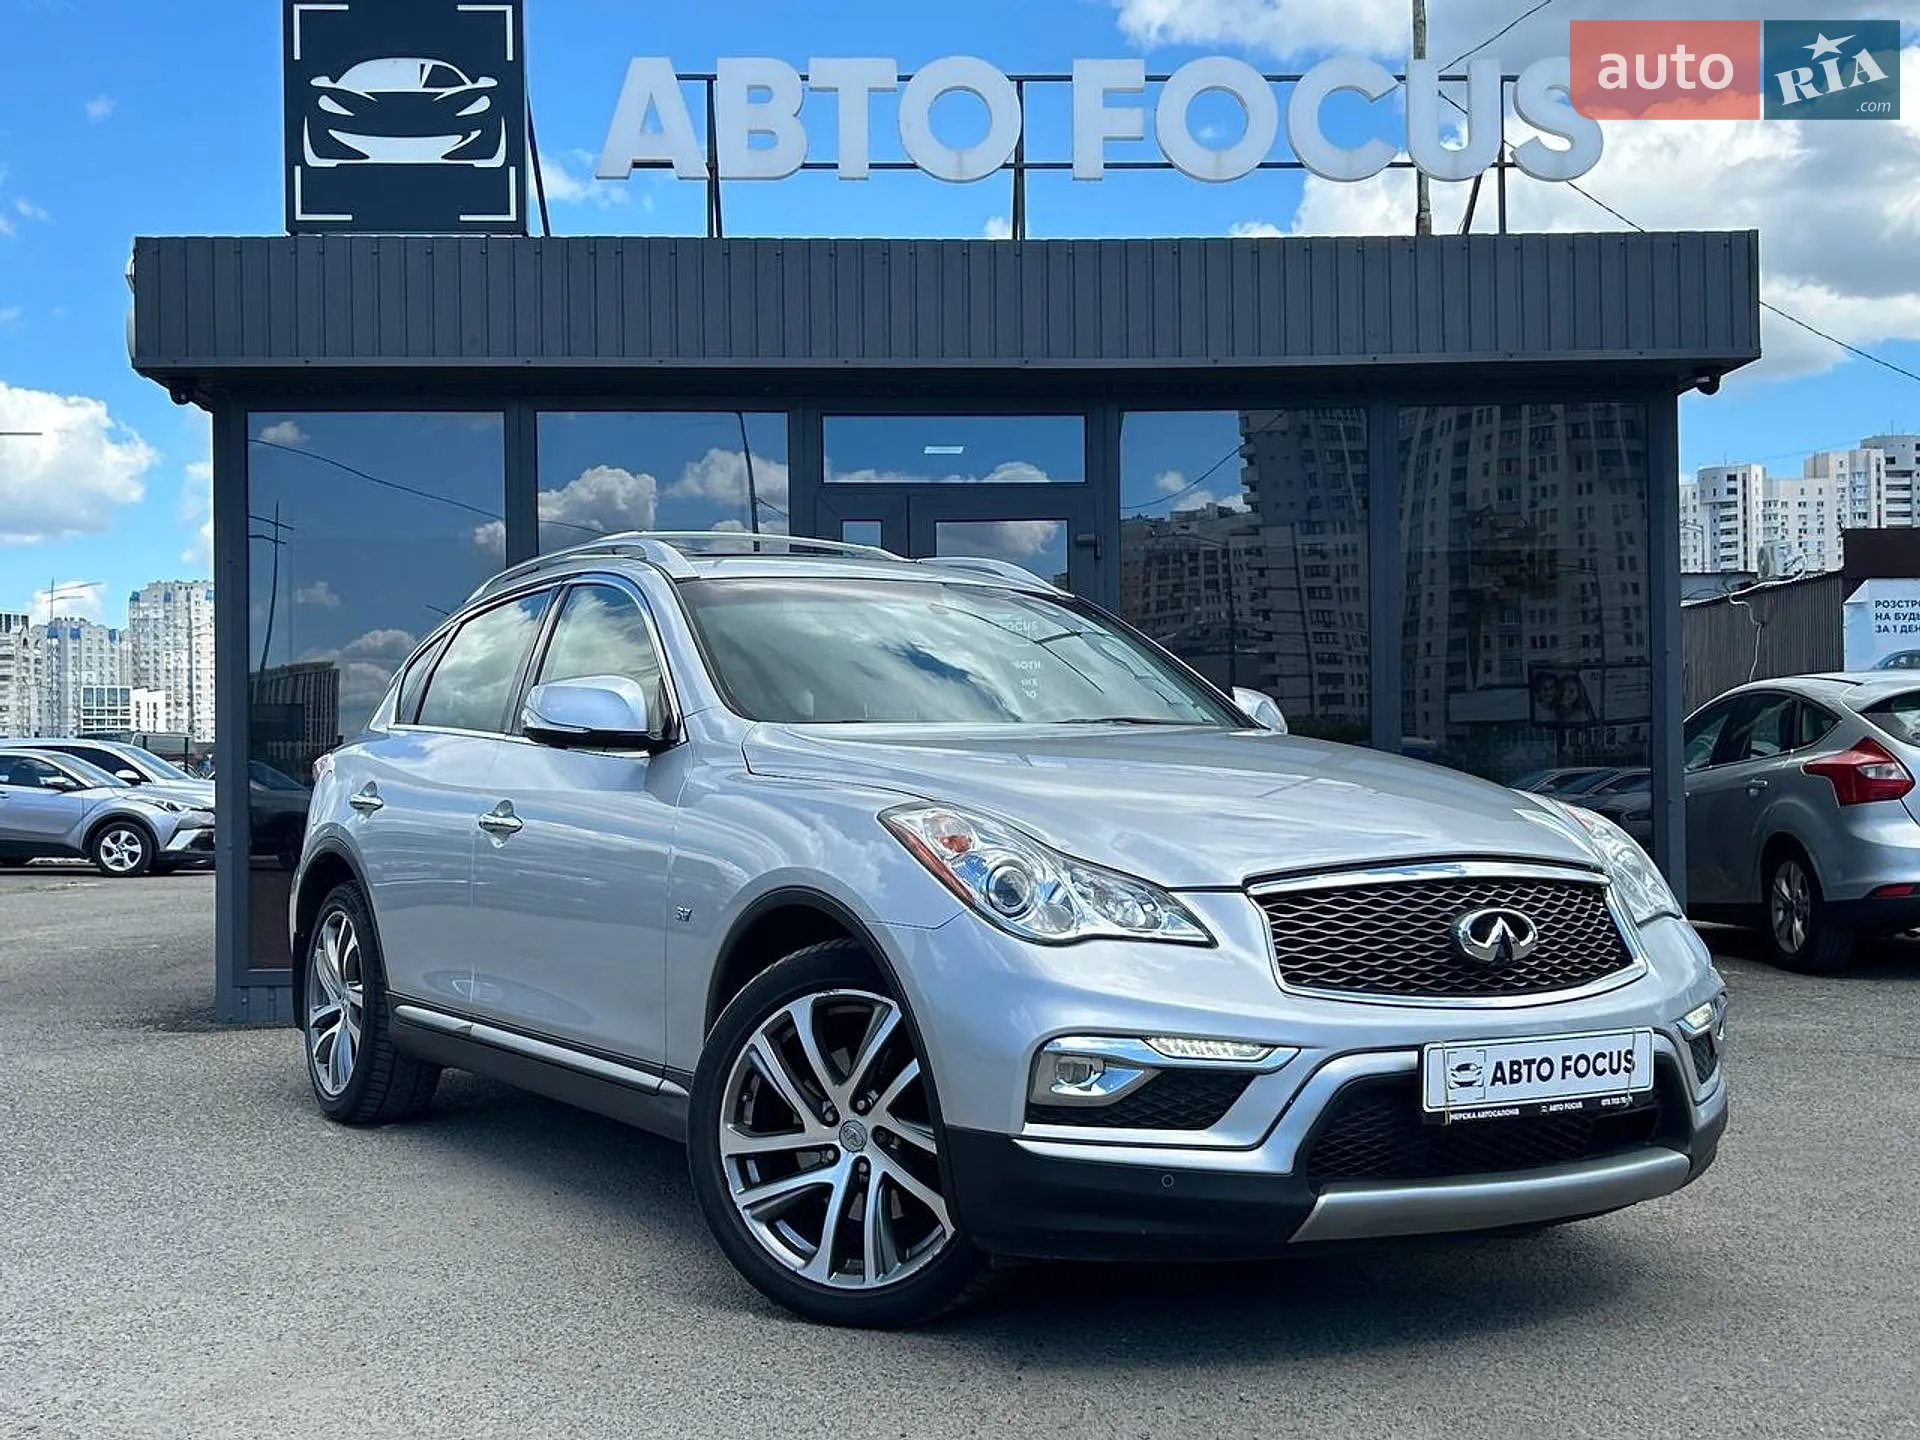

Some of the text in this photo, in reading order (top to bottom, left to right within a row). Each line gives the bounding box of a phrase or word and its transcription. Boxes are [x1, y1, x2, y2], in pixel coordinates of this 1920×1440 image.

[595, 55, 1603, 183] АВТО FOCUS
[1875, 600, 1920, 609] РОЗСТР
[1875, 613, 1891, 621] НА
[1875, 625, 1889, 634] ЗА
[1490, 1049, 1637, 1087] АВТО FOCUS
